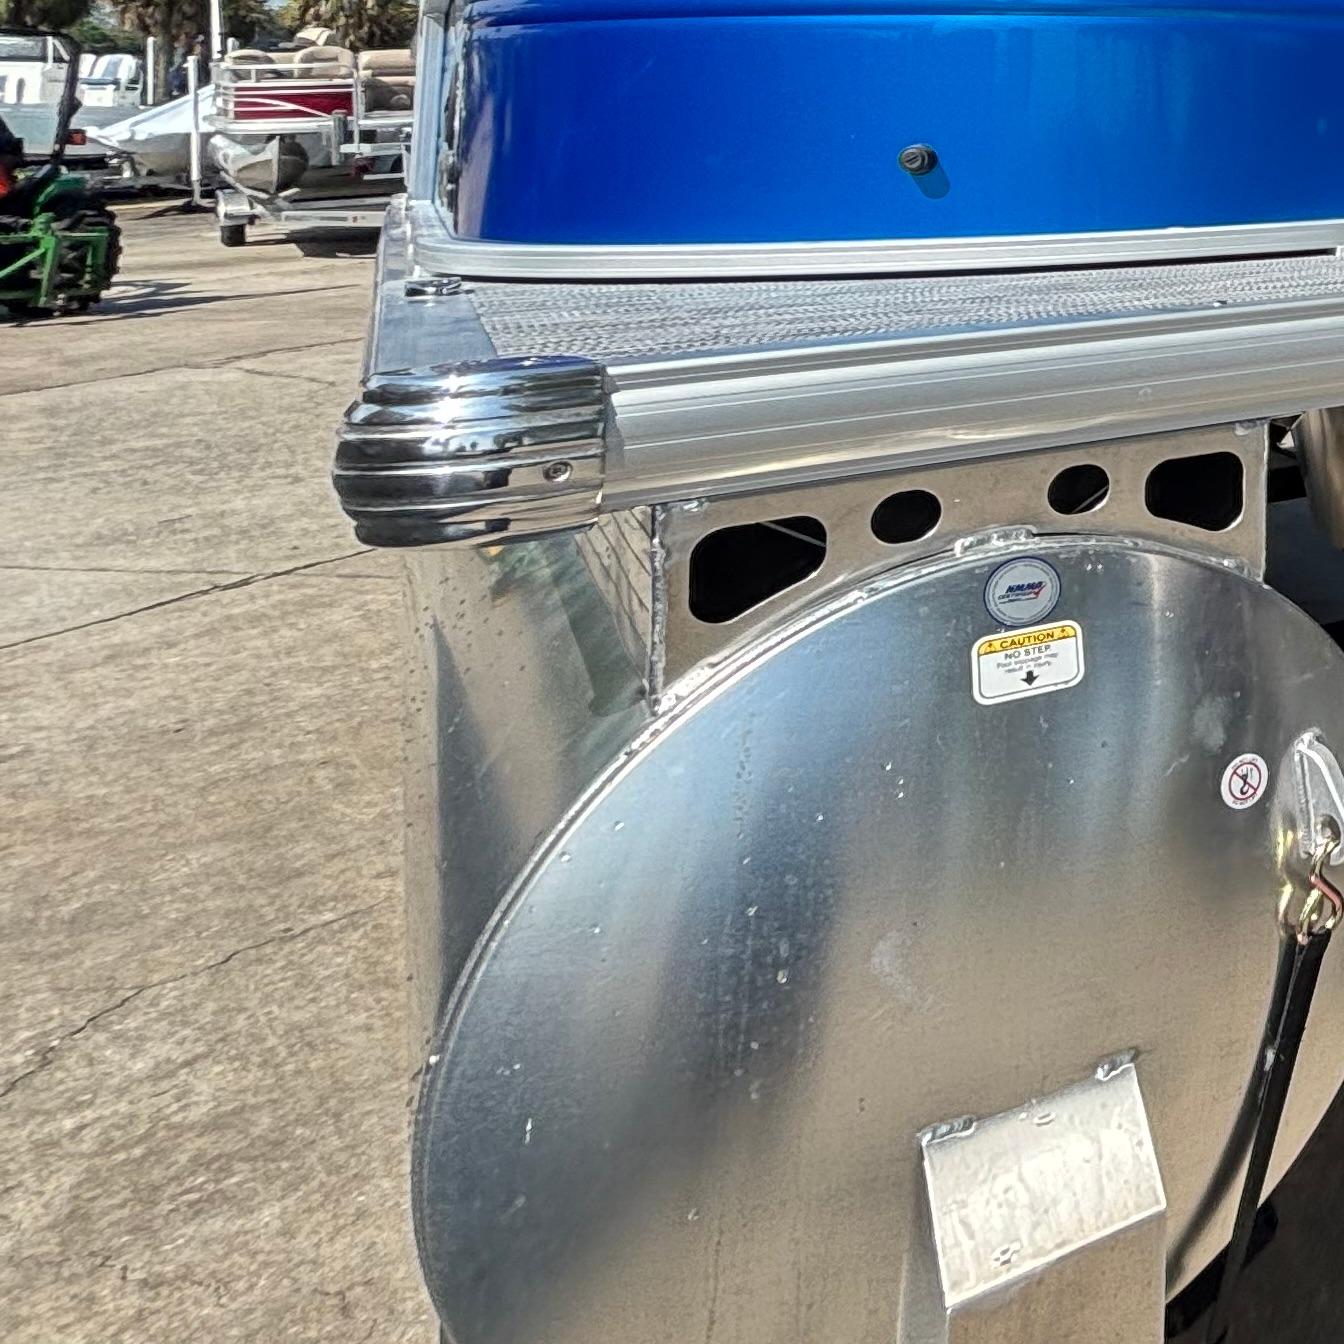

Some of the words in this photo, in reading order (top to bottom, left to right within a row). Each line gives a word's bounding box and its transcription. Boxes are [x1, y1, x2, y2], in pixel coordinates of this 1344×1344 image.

[1000, 632, 1054, 649] CAUTION
[1004, 650, 1021, 660] NO
[1024, 644, 1051, 656] STEP
